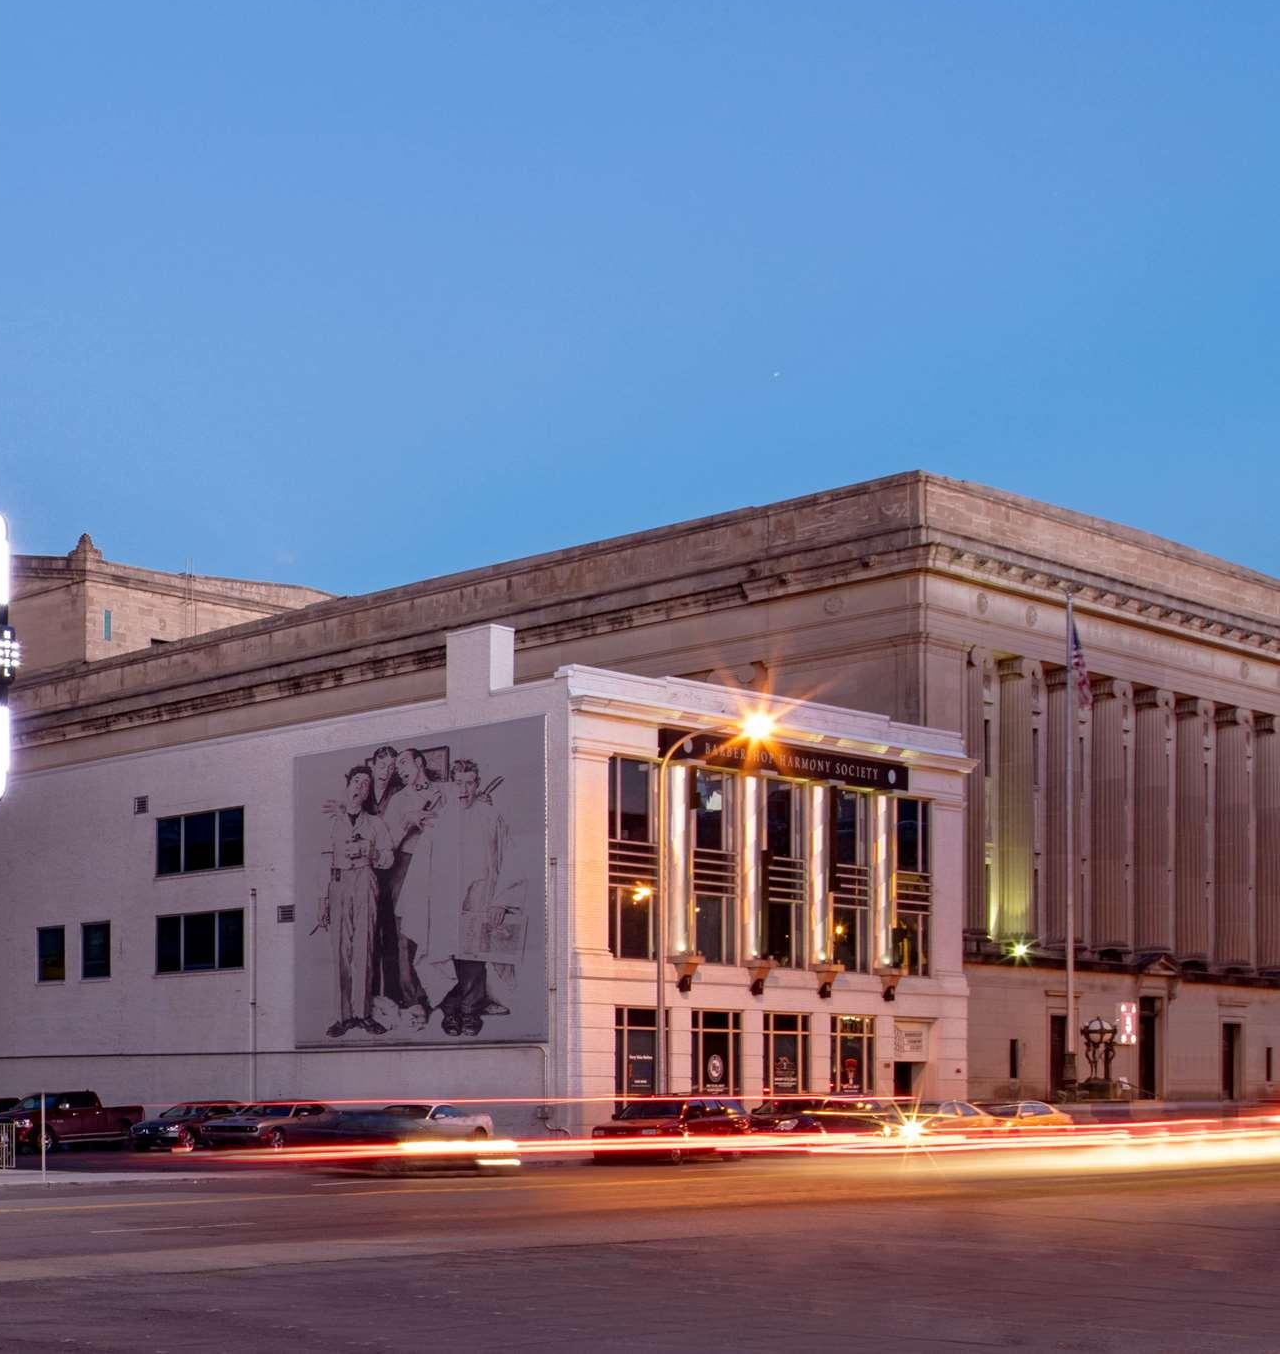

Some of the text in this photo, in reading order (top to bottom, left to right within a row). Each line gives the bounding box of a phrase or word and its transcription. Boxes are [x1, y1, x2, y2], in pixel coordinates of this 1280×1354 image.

[705, 742, 879, 781] BARBERHOP HARMONY SOCIETY
